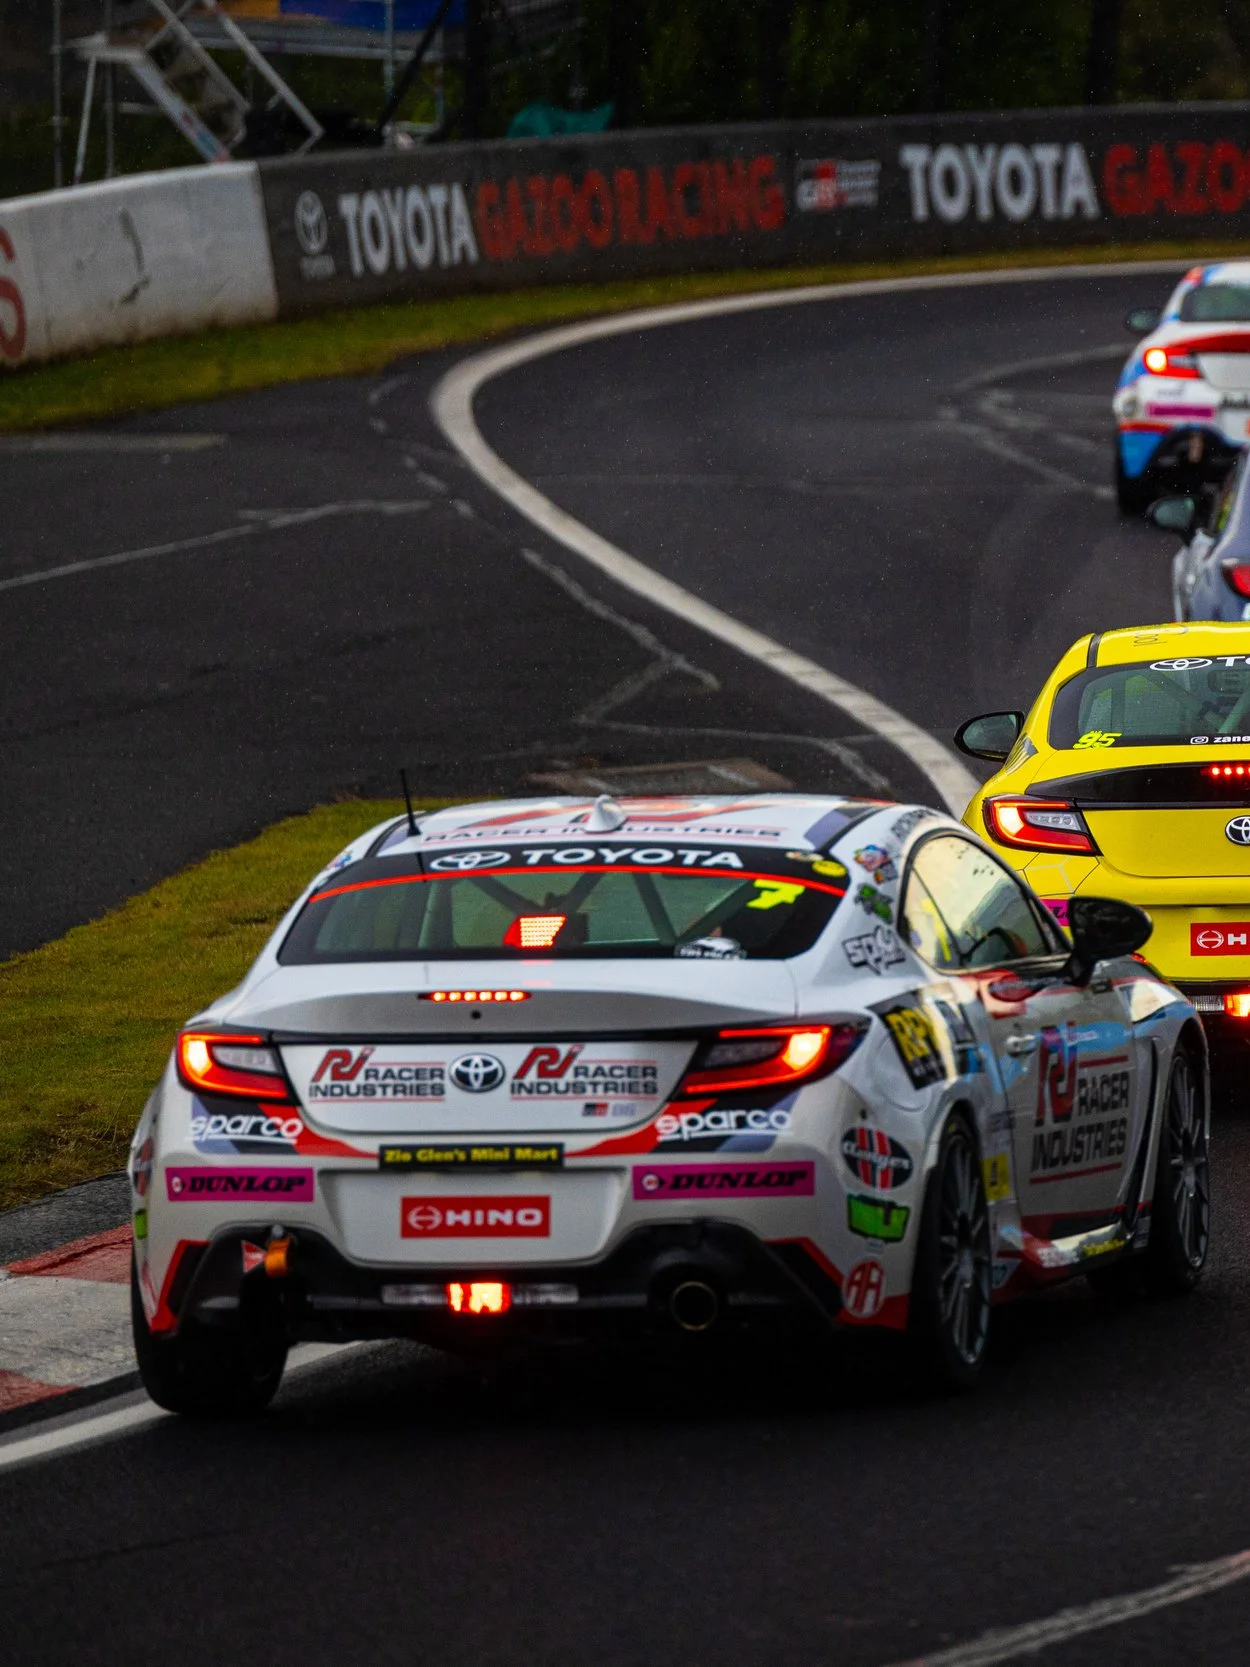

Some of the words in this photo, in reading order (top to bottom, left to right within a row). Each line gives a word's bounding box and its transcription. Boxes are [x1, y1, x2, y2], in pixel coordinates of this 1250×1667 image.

[901, 142, 1098, 223] TOYOTA
[338, 182, 480, 277] TOYOTA
[475, 170, 613, 260] GAZOO
[521, 848, 744, 869] TOYOTA
[364, 1067, 445, 1081] RACER
[573, 1065, 658, 1080] RACER
[308, 1083, 446, 1098] INDUSTRIES
[510, 1081, 659, 1095] INDUSTRIES
[1078, 1071, 1130, 1117] RACER
[188, 1114, 304, 1141] sparco
[654, 1108, 793, 1140] sparco
[471, 1148, 510, 1162] Mini
[514, 1148, 559, 1161] Mart
[1031, 1117, 1128, 1173] INDUSTRIES
[187, 1175, 306, 1192] DUNLOP
[668, 1170, 808, 1190] DUNLOP
[445, 1208, 543, 1227] HINO
